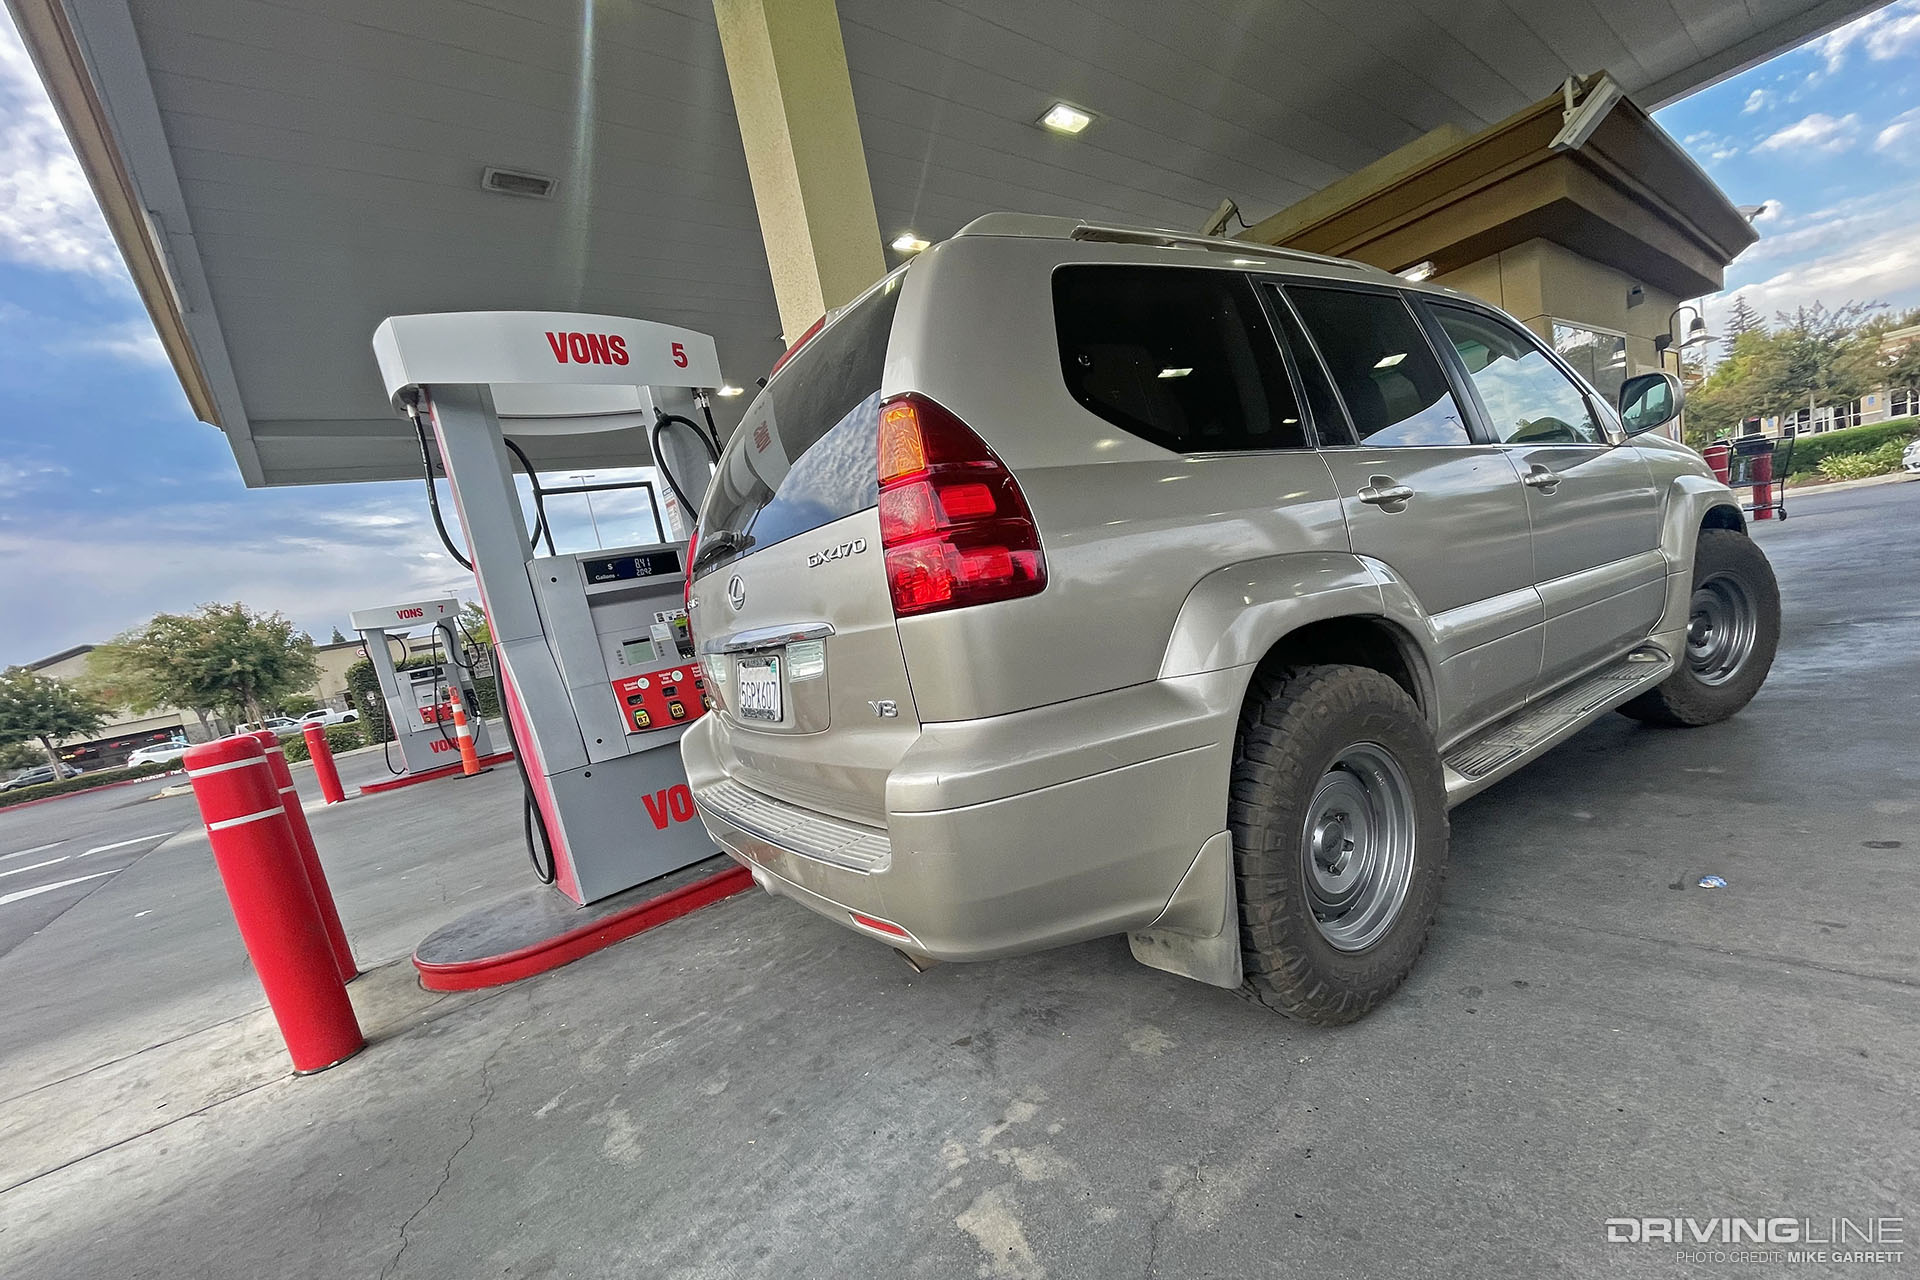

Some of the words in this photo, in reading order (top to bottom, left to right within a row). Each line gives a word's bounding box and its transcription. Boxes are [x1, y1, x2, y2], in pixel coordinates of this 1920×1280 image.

[544, 331, 630, 366] VONS
[671, 342, 688, 369] 5
[807, 538, 867, 568] GX470
[396, 607, 424, 620] VONS
[437, 605, 444, 613] 7
[867, 699, 899, 718] V8
[430, 736, 460, 753] VON
[641, 783, 699, 831] VO
